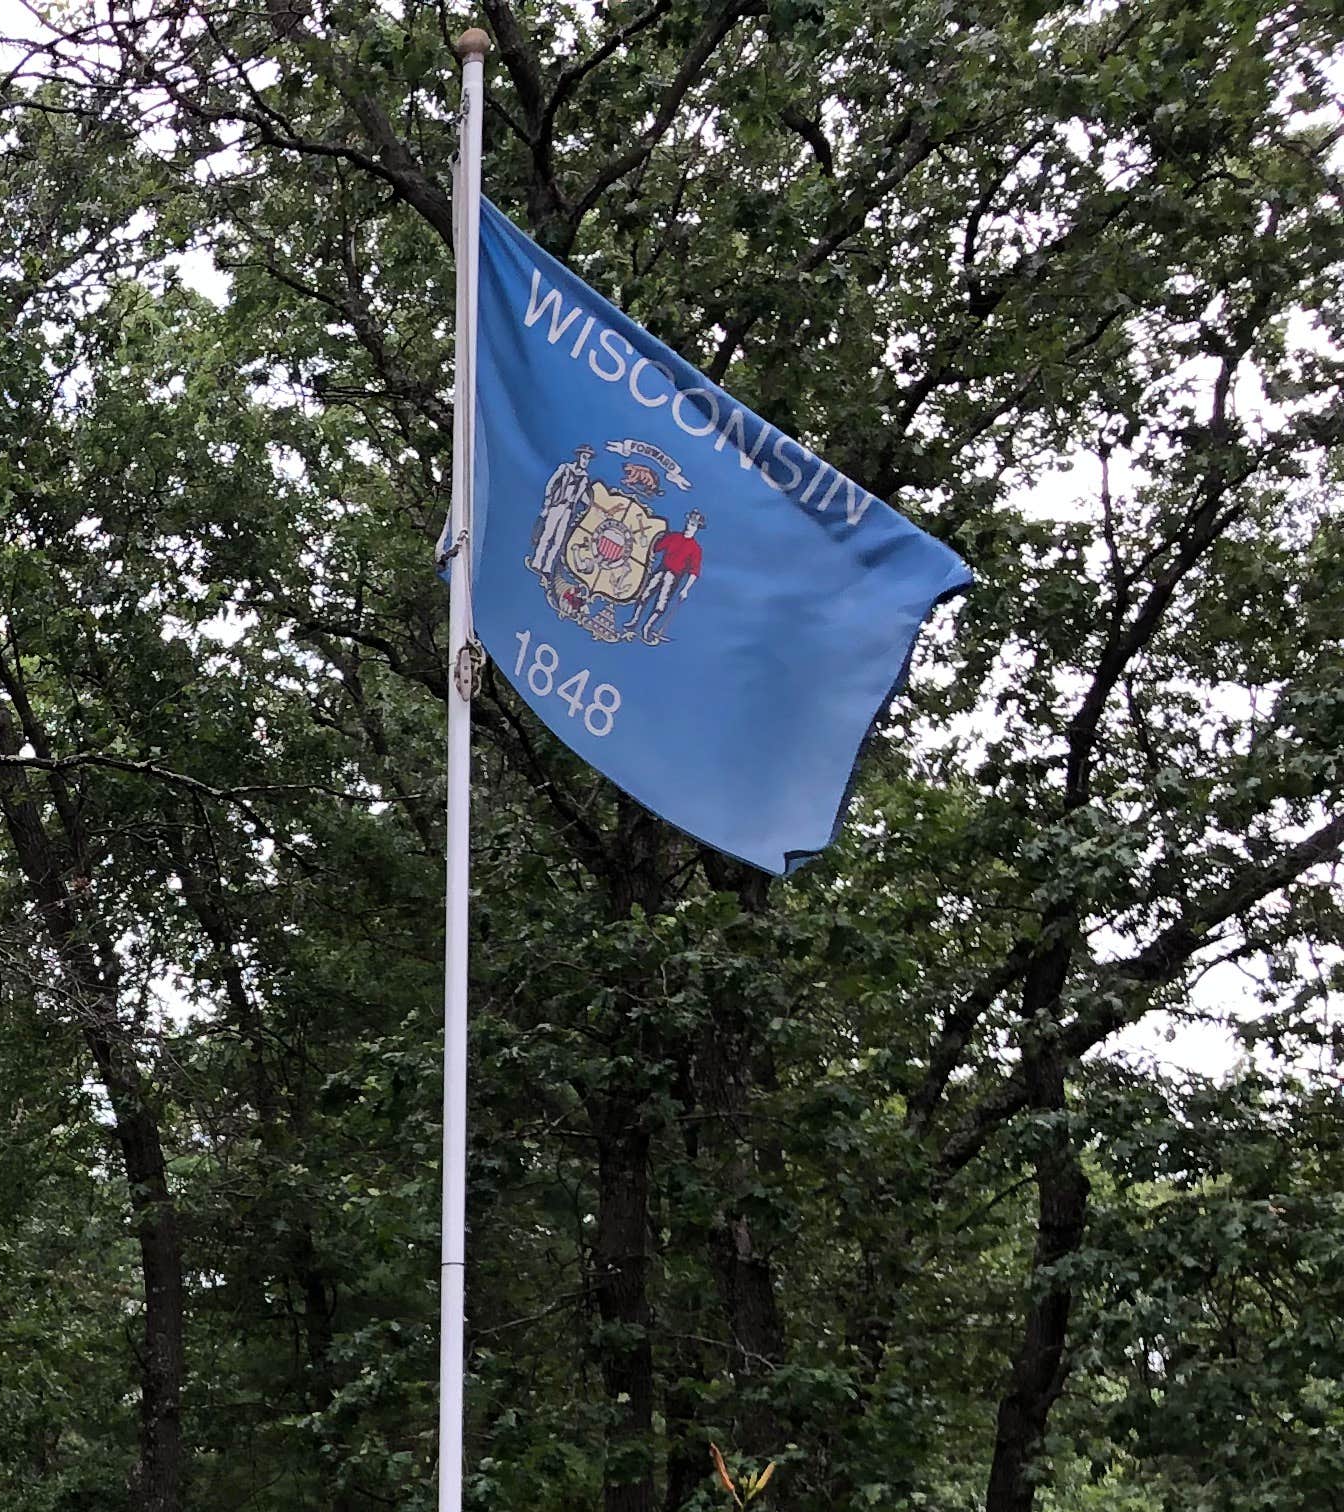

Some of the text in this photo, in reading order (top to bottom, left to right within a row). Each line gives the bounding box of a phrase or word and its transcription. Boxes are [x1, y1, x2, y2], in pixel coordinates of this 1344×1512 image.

[523, 269, 874, 526] WISCONSIN
[630, 442, 676, 471] FORWARD
[514, 630, 621, 737] 1848
